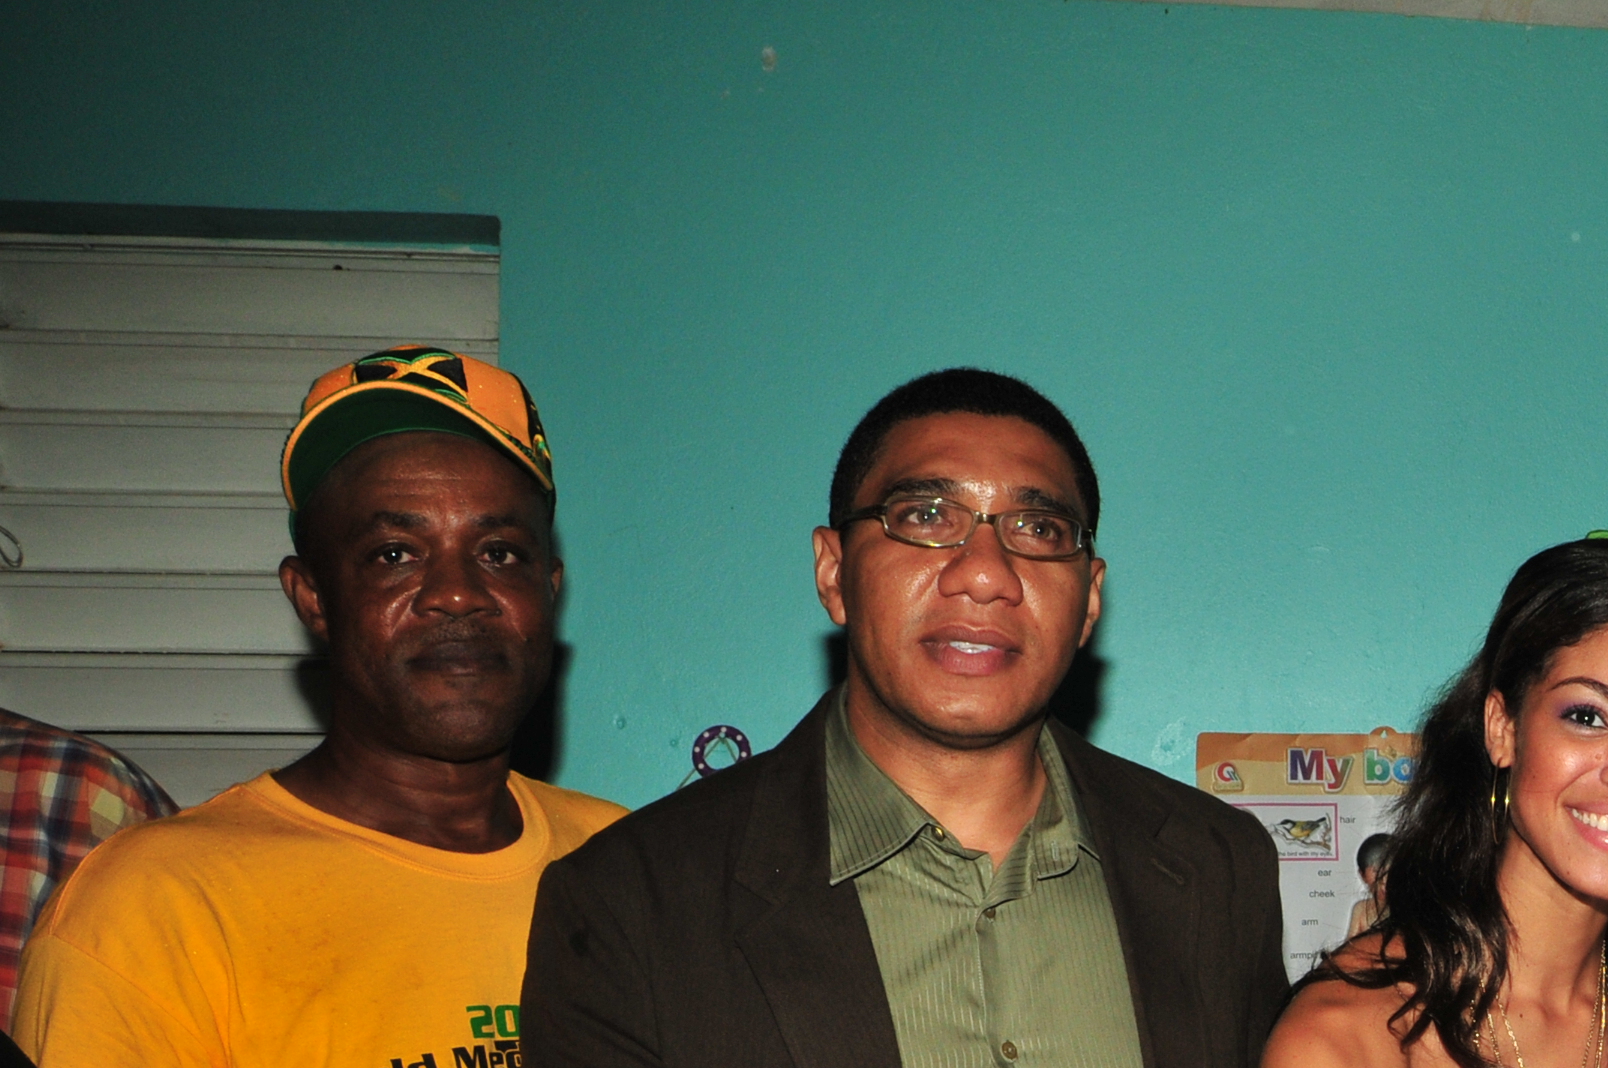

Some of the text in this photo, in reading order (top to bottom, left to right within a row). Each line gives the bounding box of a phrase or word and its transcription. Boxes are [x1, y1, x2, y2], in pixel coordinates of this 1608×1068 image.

[1287, 747, 1354, 792] My
[1339, 815, 1356, 824] hair
[1317, 869, 1332, 877] ear
[1308, 889, 1335, 898] cheek
[1301, 918, 1319, 926] arm
